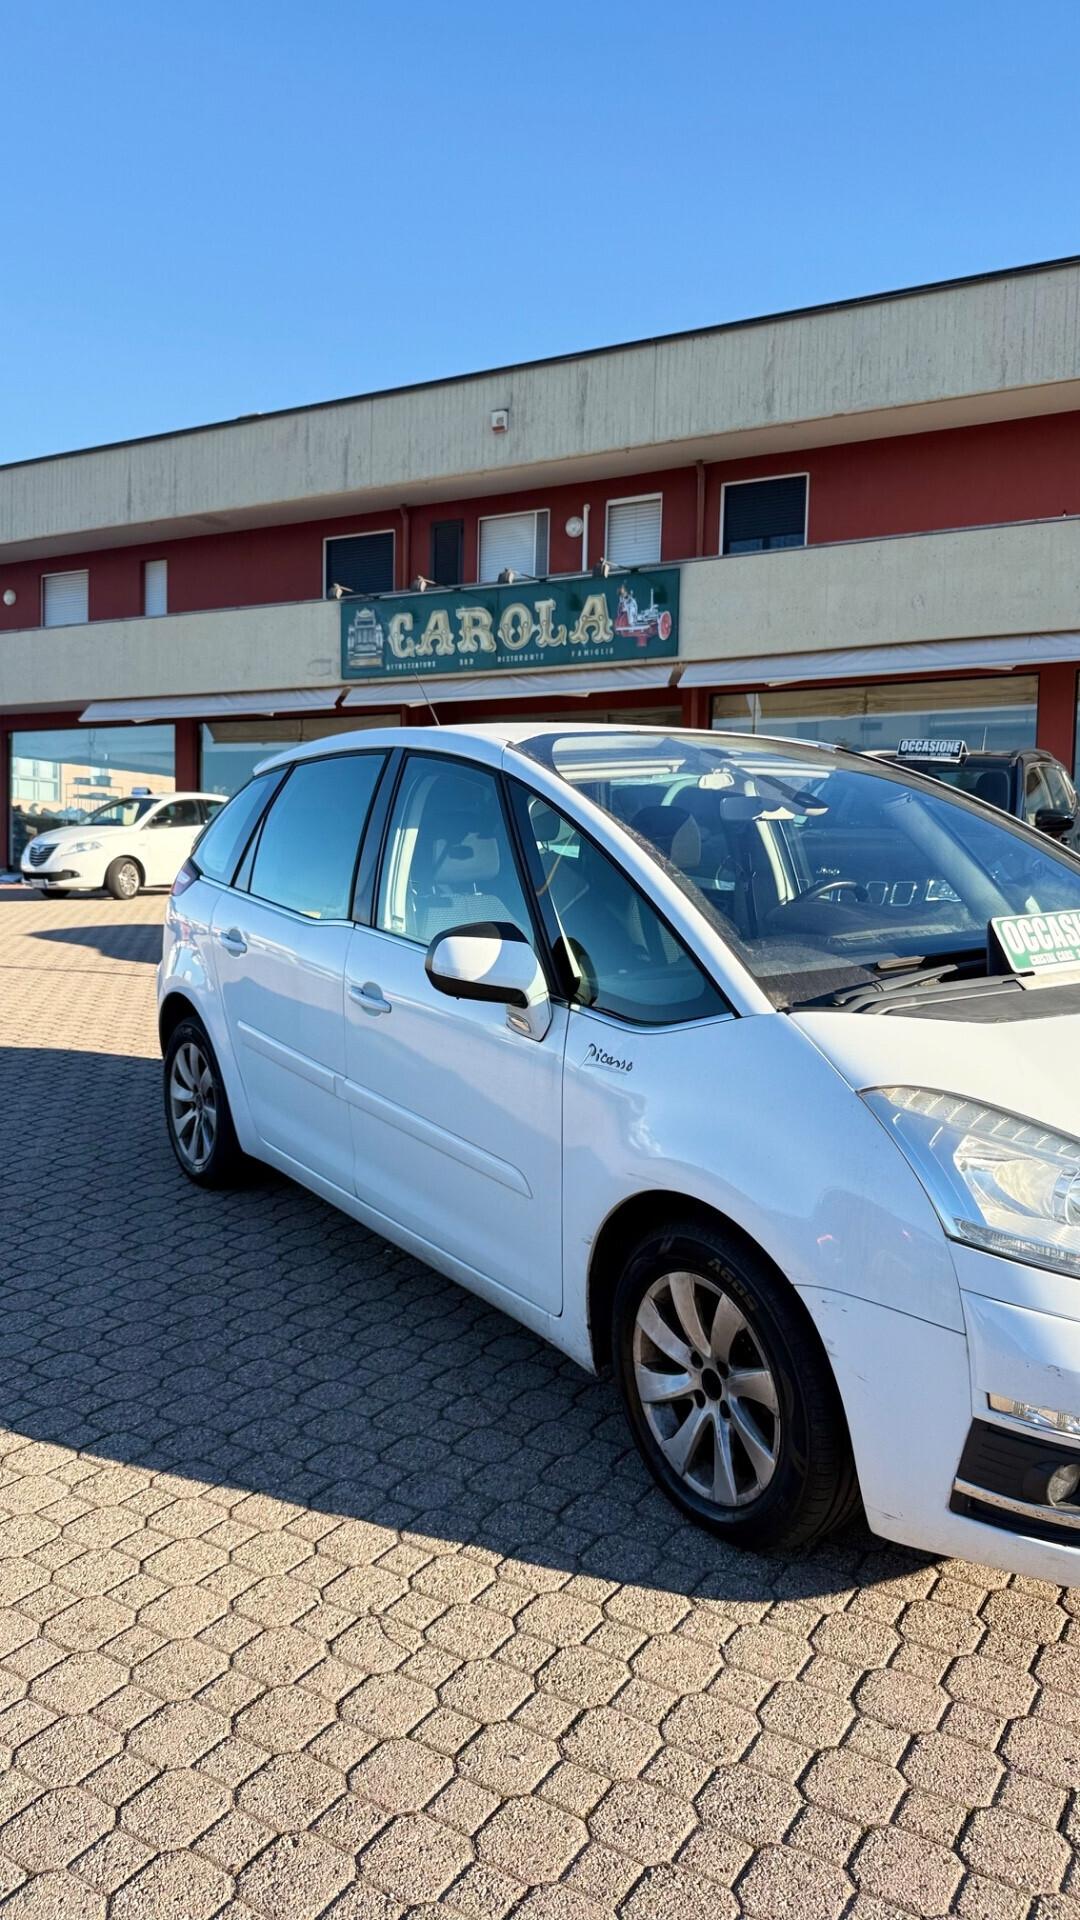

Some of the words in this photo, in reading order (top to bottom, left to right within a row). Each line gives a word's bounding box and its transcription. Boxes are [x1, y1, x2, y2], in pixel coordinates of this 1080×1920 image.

[387, 592, 614, 659] CAROLA
[900, 740, 961, 753] OCCASIONE
[1001, 912, 1080, 955] OCCASI
[579, 1042, 634, 1073] Picasso
